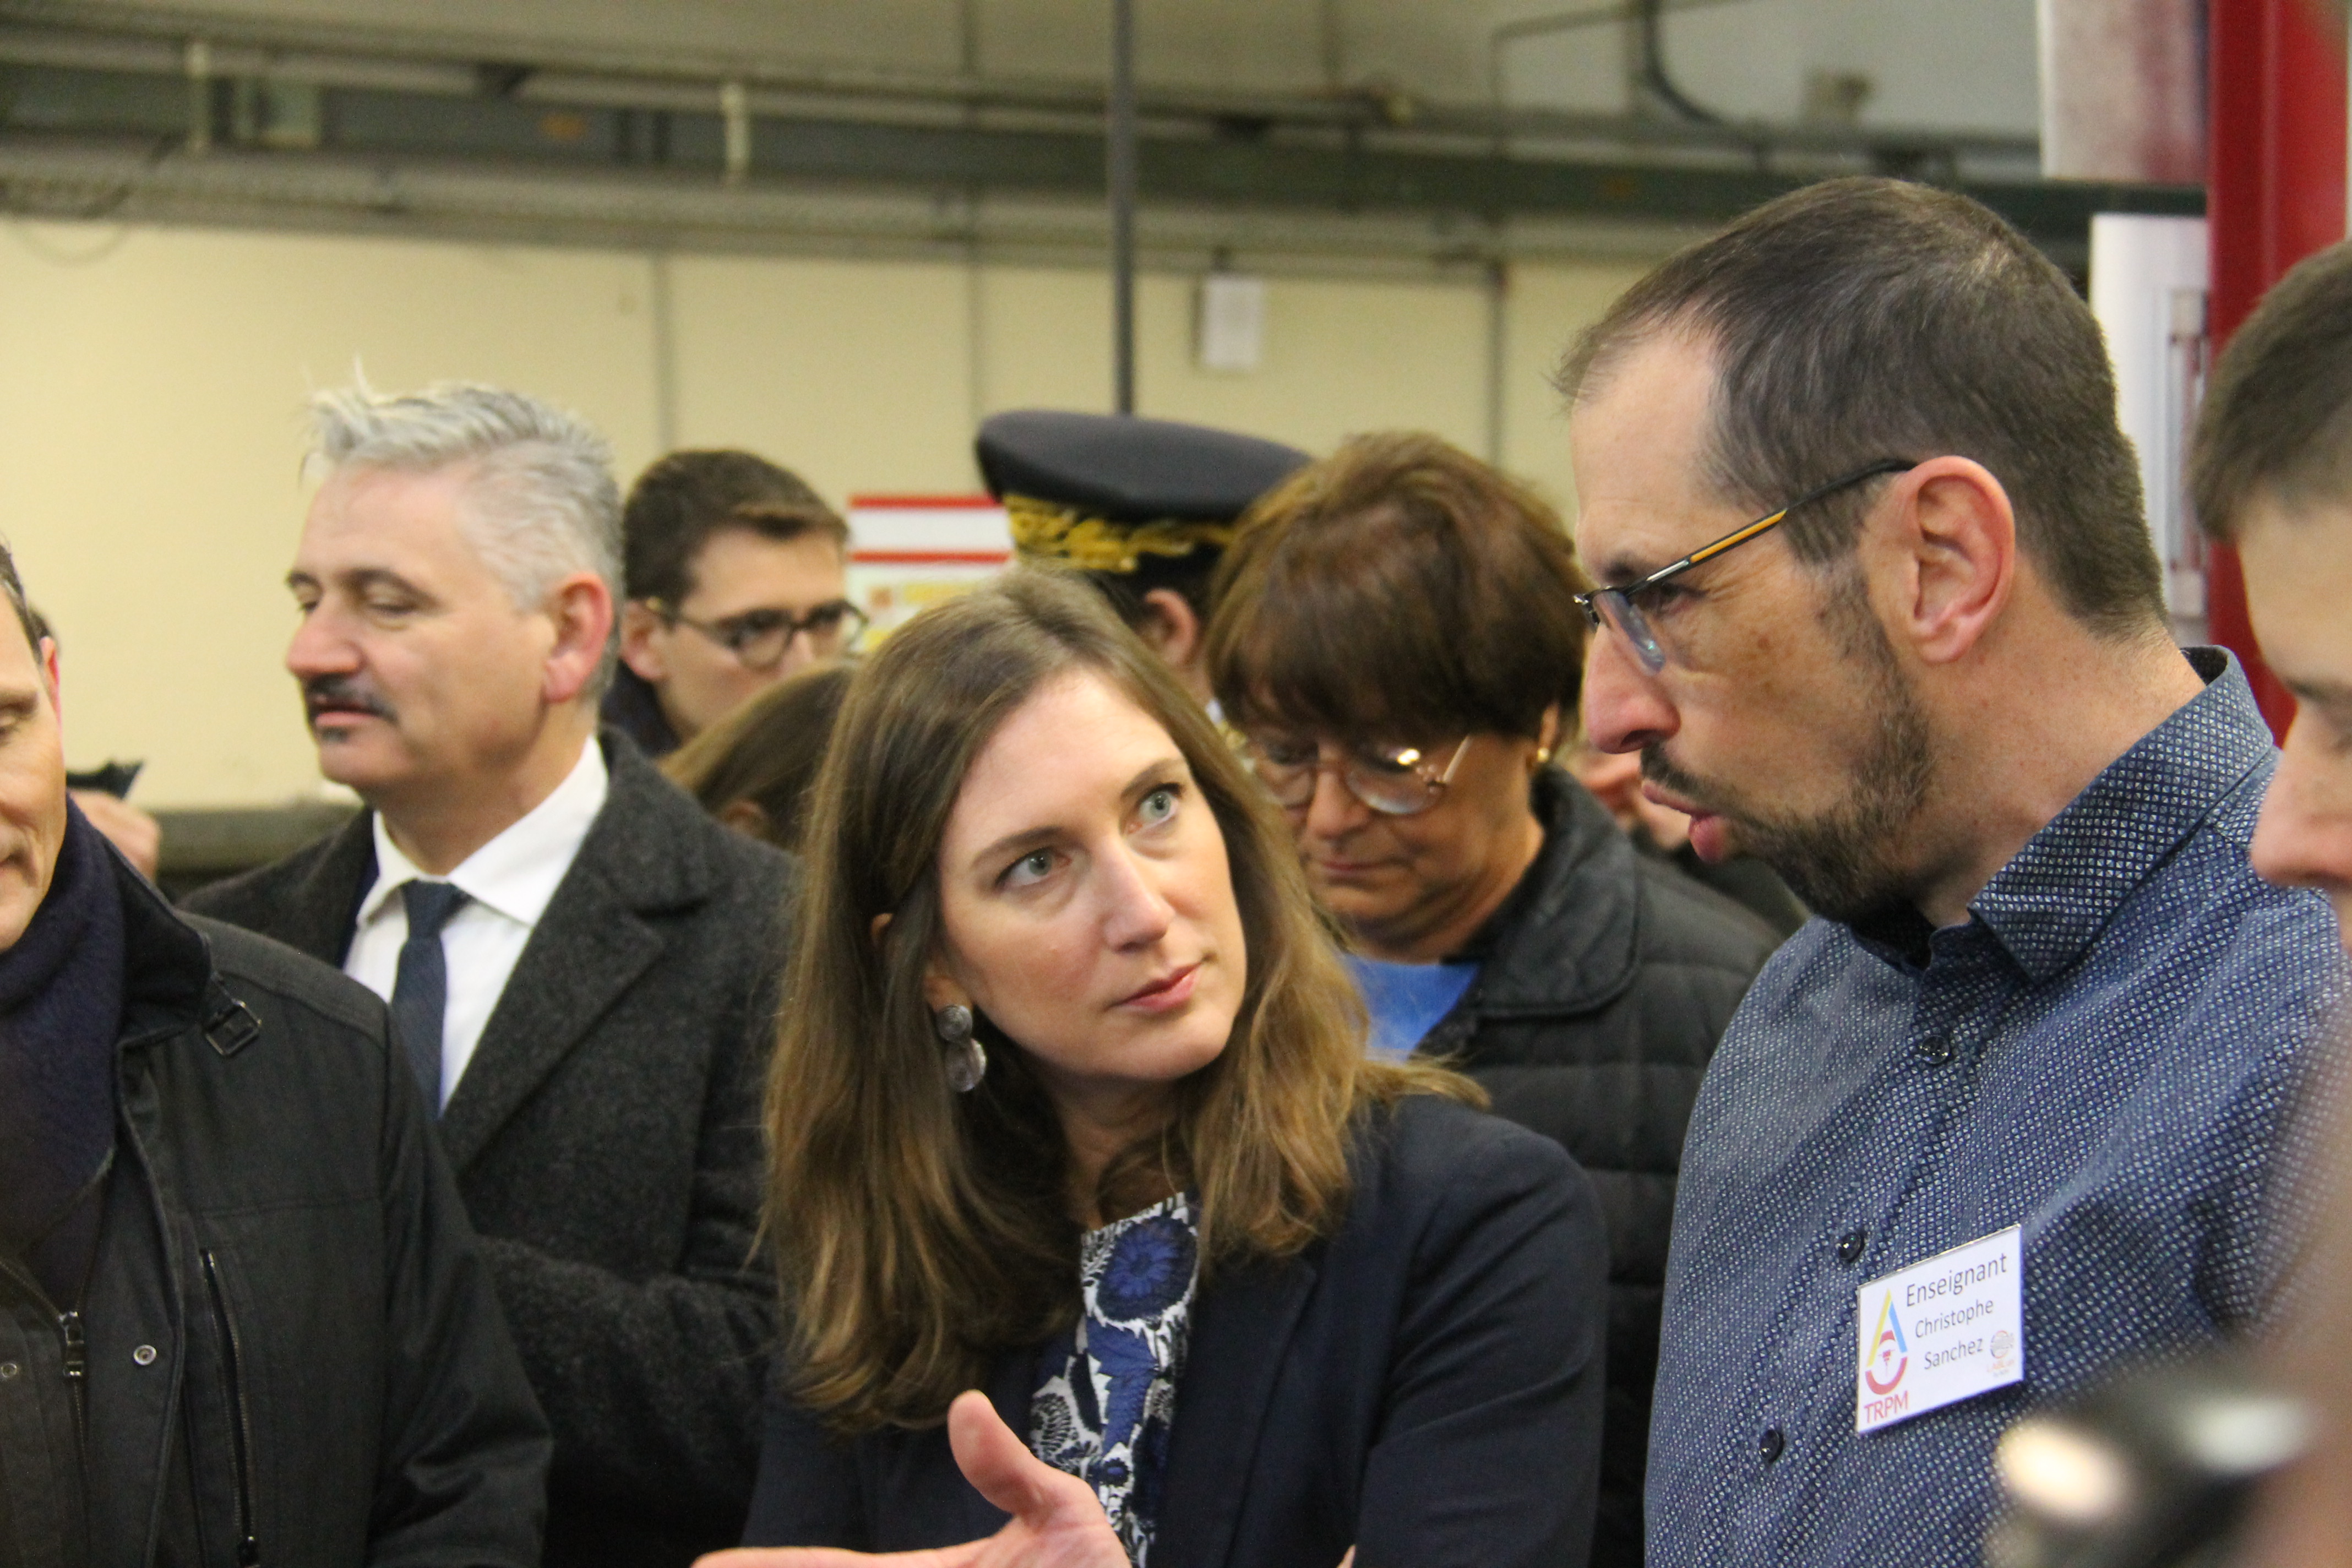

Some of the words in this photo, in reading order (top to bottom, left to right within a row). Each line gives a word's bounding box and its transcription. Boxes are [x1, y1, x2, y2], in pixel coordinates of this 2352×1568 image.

[1907, 1253, 2007, 1306] Enseignant
[1915, 1300, 1993, 1338] Christophe
[1924, 1338, 1983, 1370] Sanchez
[1864, 1391, 1909, 1423] TRPM
